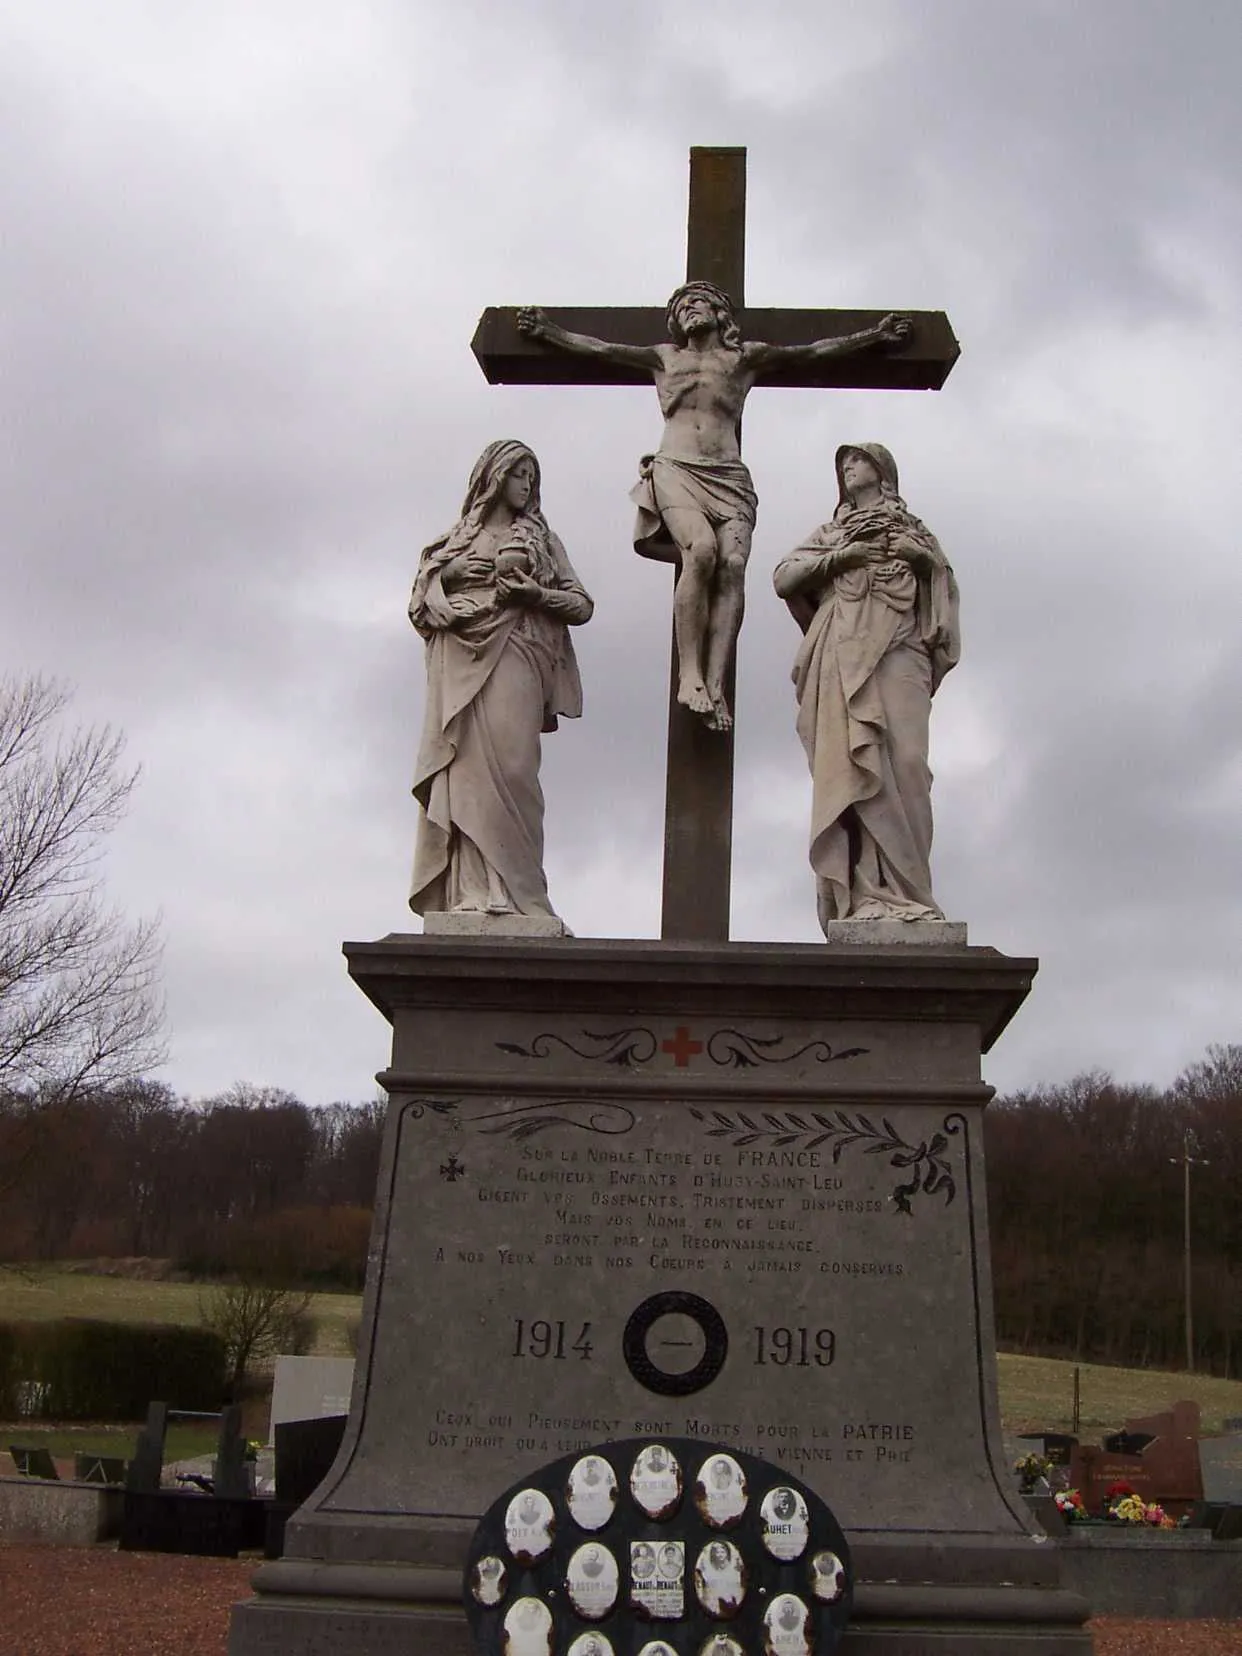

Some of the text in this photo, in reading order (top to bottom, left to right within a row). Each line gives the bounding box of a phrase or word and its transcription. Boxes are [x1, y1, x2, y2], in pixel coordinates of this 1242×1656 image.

[521, 1149, 821, 1168] SUR LA NOBLE TERRE DE FRANCE
[517, 1167, 595, 1183] GLORIEUX
[609, 1170, 677, 1187] ENFANTS
[693, 1193, 785, 1209] TRISTEMENT
[555, 1211, 592, 1225] MAIS
[606, 1214, 633, 1227] VOS
[704, 1218, 722, 1229] EN
[736, 1218, 753, 1230] CE
[544, 1234, 599, 1247] SERONT
[614, 1236, 639, 1248] PAR
[652, 1236, 669, 1248] LA
[458, 1251, 484, 1264] NOS
[499, 1250, 534, 1265] YEUX
[554, 1253, 592, 1267] DANS
[606, 1254, 633, 1268] NOS
[748, 1259, 801, 1273] JAMAIS
[512, 1319, 836, 1366] 1914 1919
[436, 1409, 914, 1440] CEUX QUI PIEUSEMENT SONT MORTS POUR LA PATRIE
[428, 1431, 458, 1447] ONT
[465, 1436, 504, 1449] DROIT
[778, 1447, 832, 1462] VIENNE
[847, 1449, 862, 1461] ET
